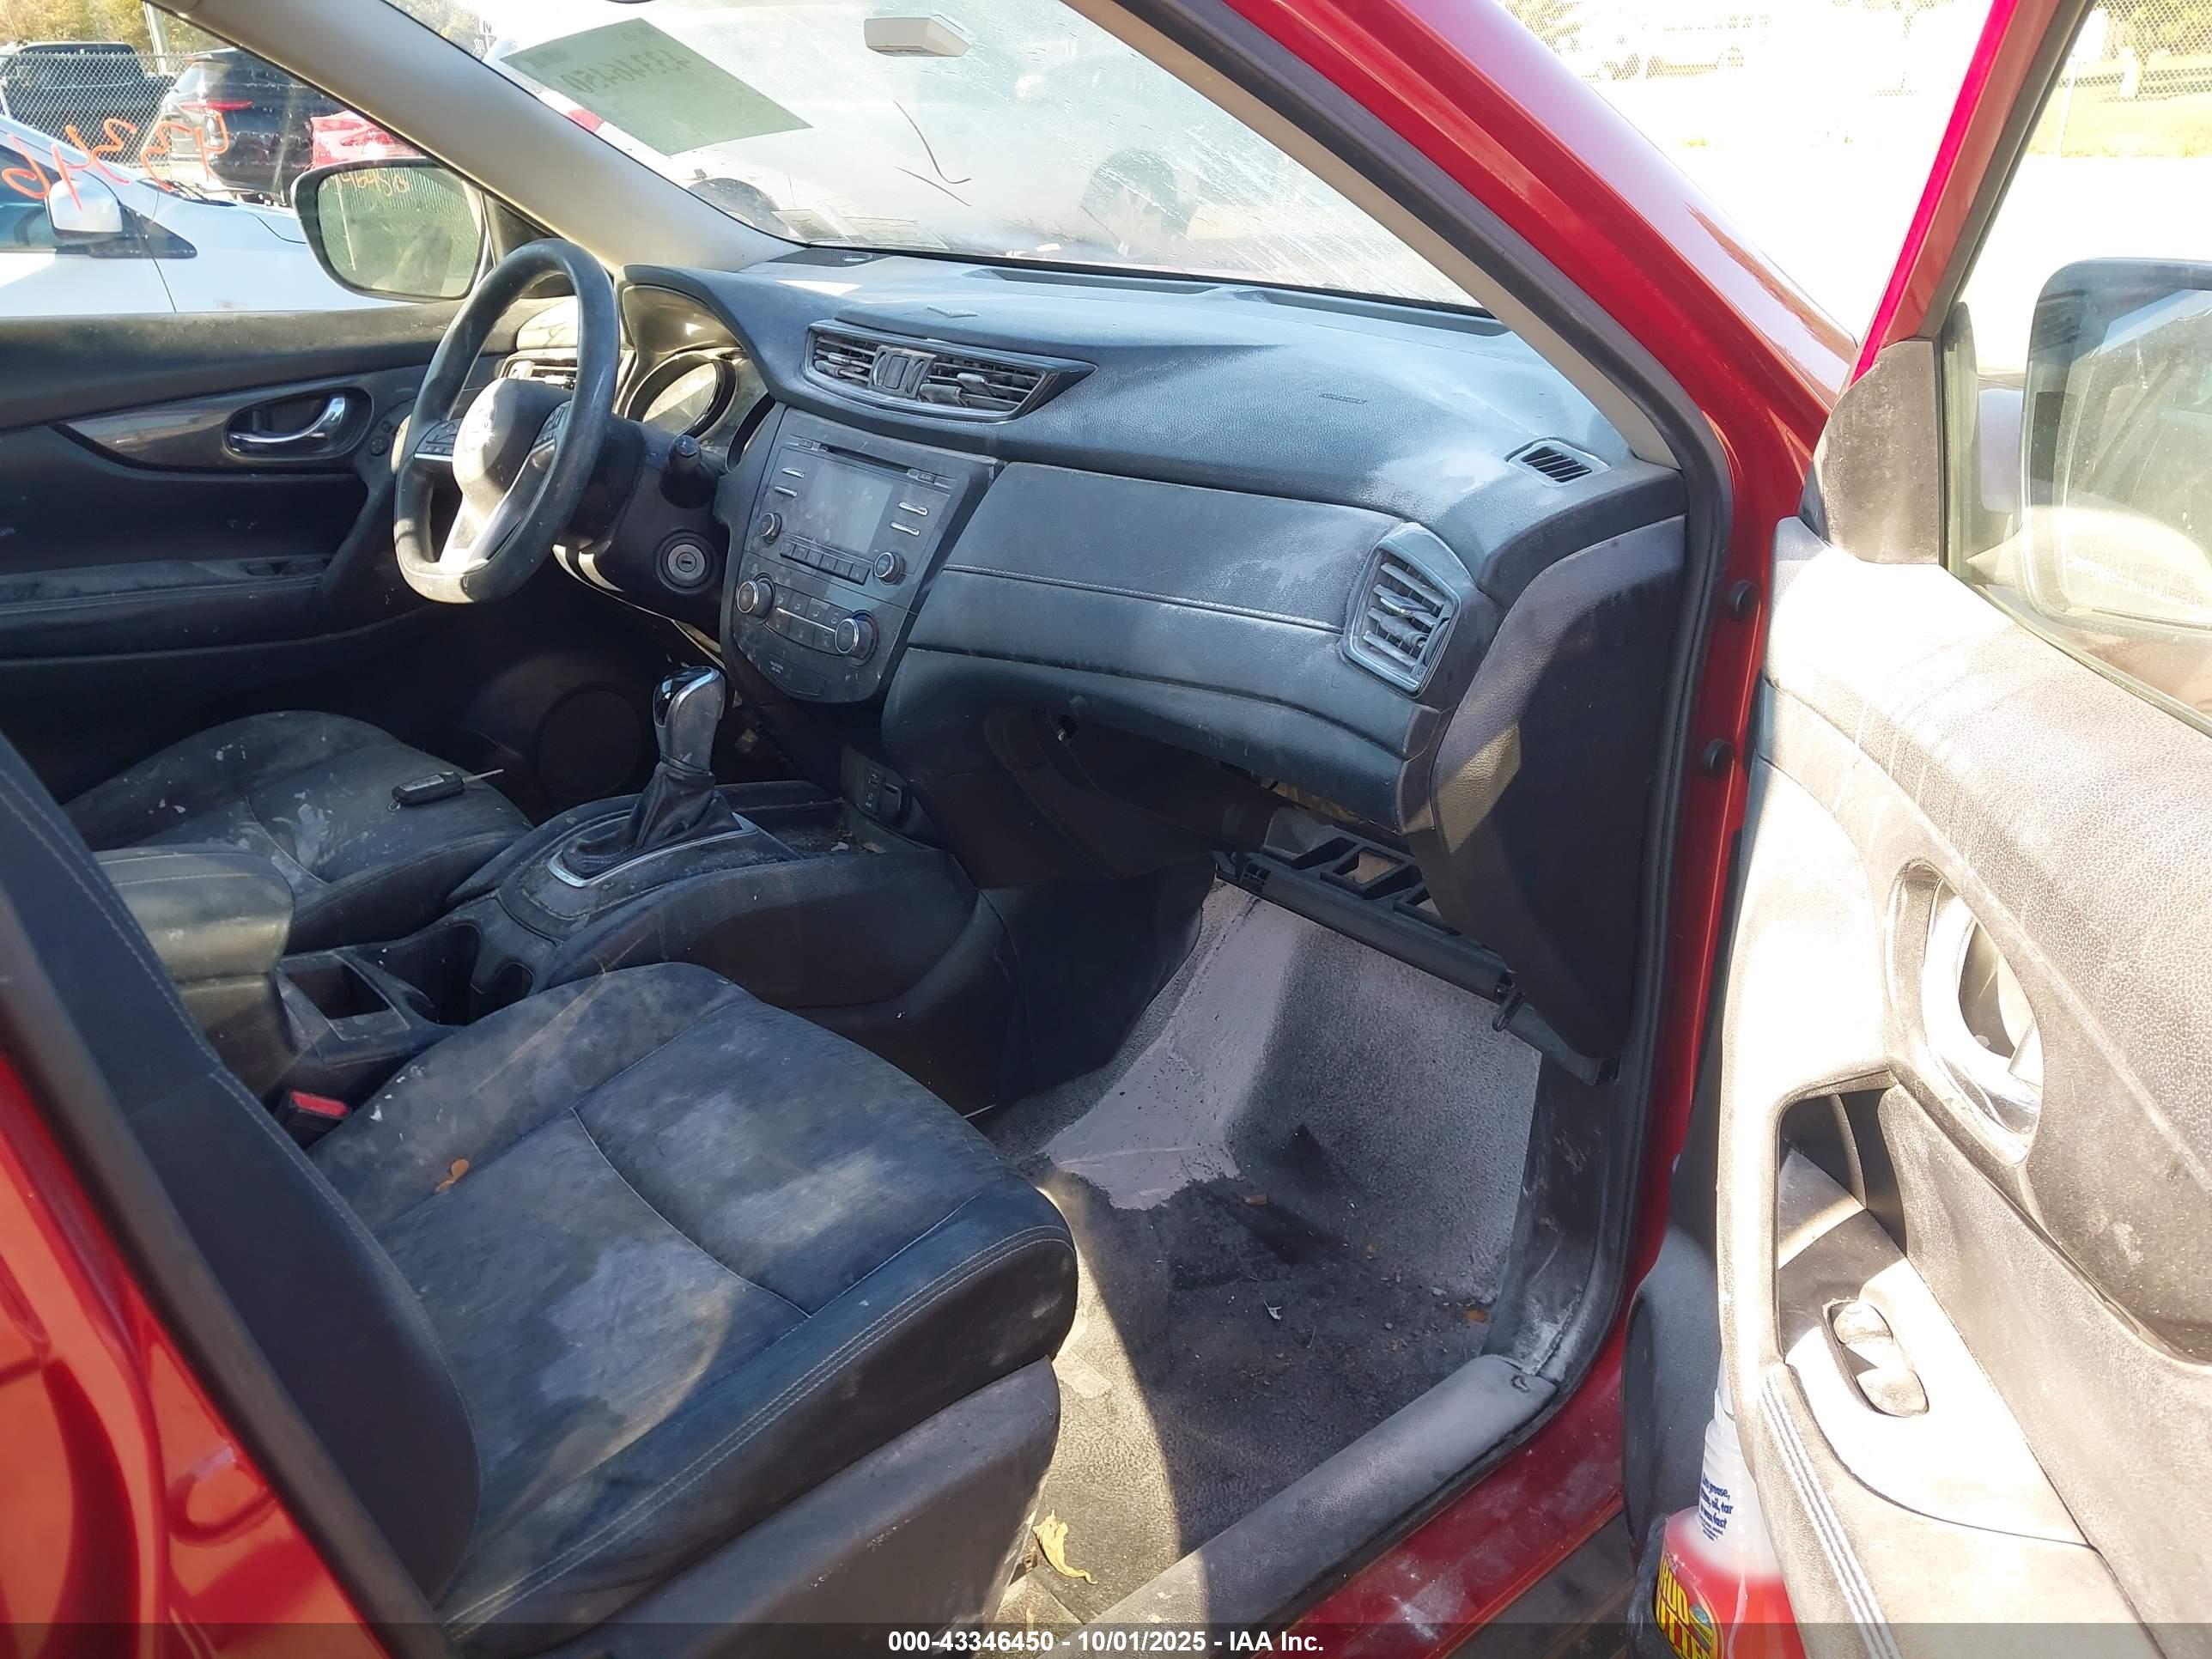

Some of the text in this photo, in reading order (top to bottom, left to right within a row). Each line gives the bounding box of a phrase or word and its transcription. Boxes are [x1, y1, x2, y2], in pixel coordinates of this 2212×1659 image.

[2134, 577, 2158, 594] THEY
[2160, 585, 2205, 605] APPEAR
[1709, 1483, 1730, 1500] grease,
[1721, 1501, 1734, 1514] tar
[1713, 1512, 1728, 1529] fast
[1658, 1556, 1690, 1626] RUD
